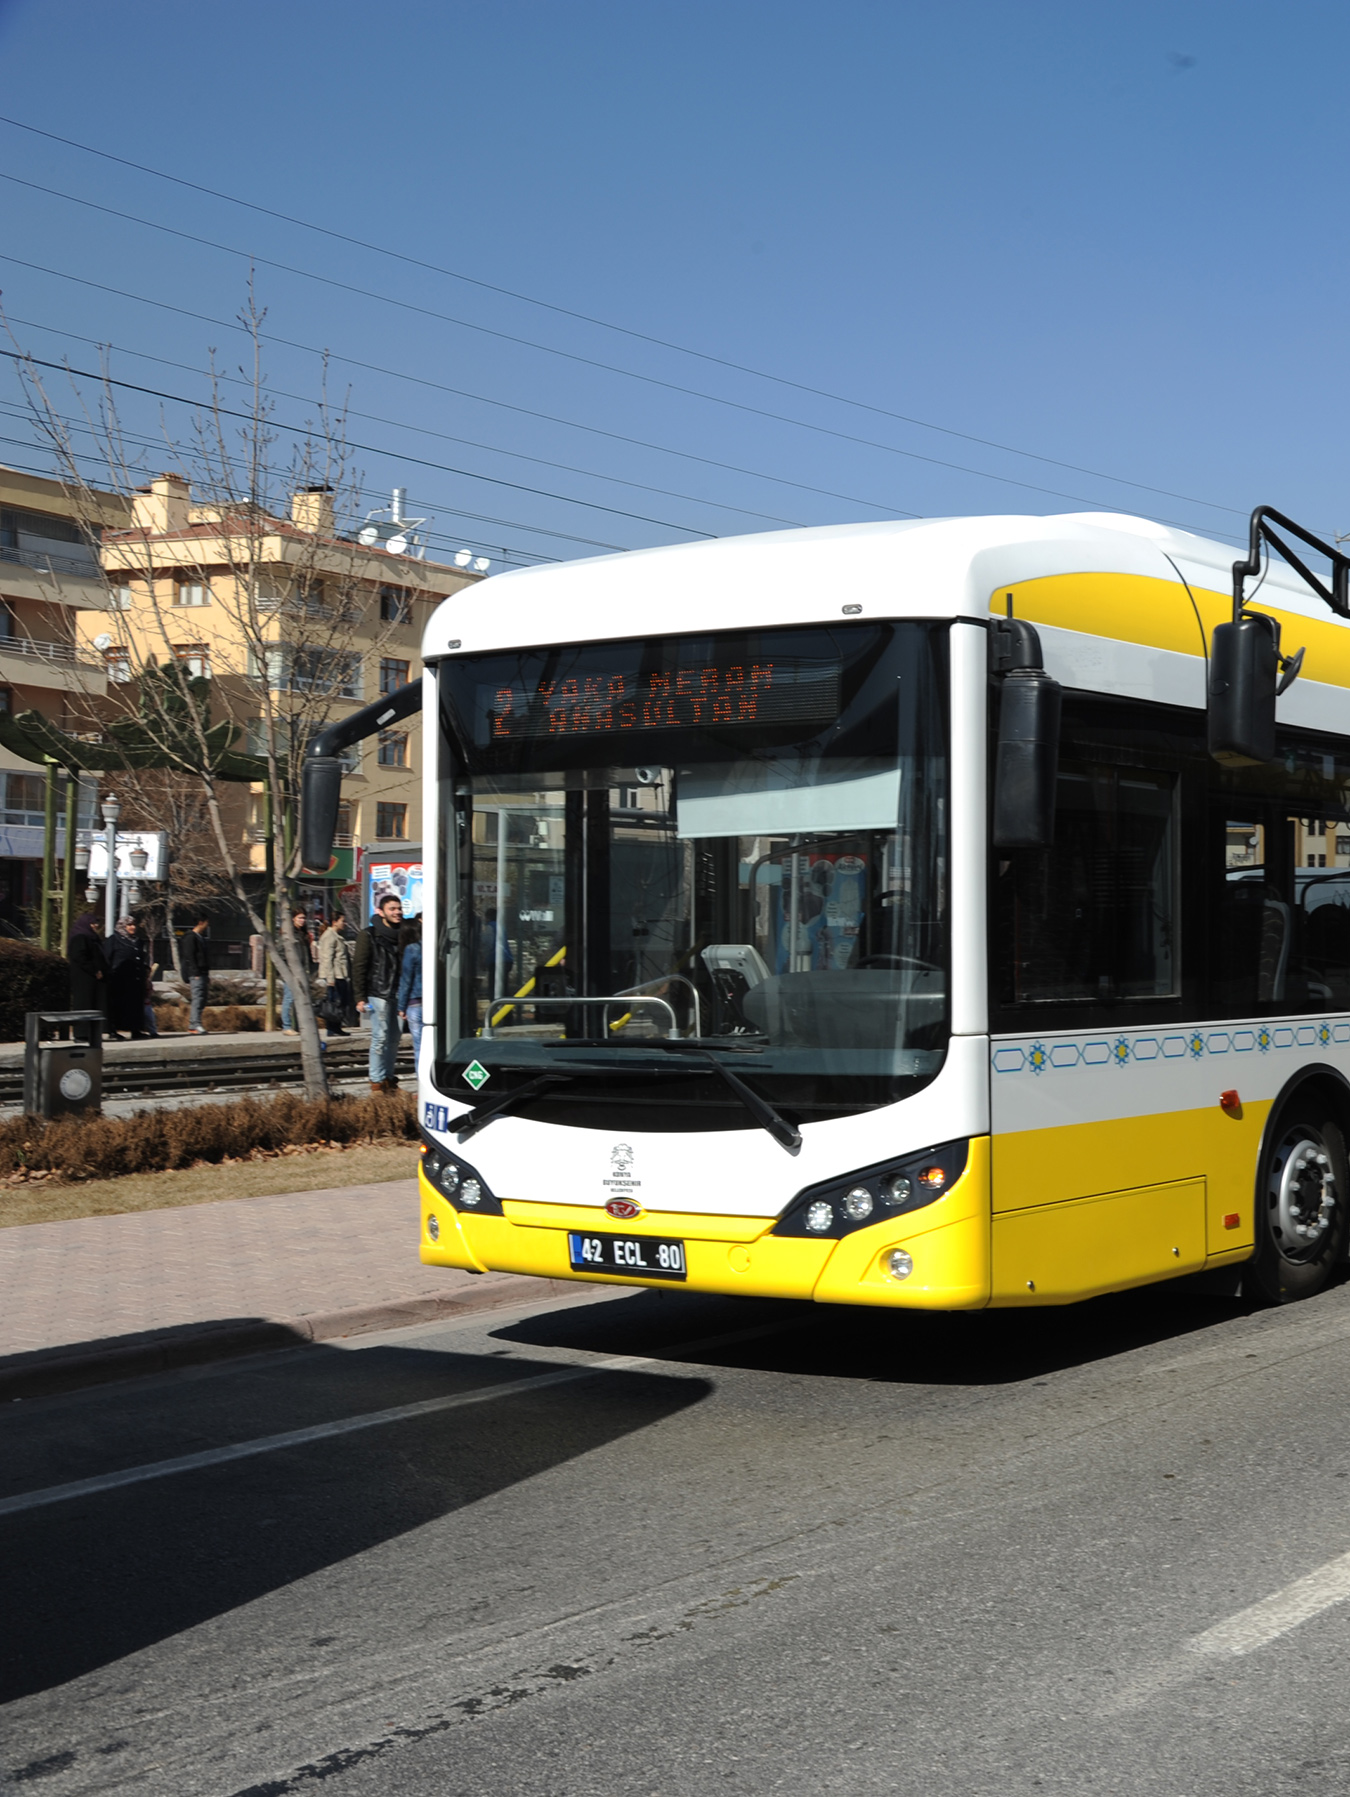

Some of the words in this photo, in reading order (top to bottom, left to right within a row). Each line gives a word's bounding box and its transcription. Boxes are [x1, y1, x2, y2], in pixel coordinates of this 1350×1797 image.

[494, 687, 513, 735] 2
[538, 674, 625, 705] YAKA
[649, 663, 774, 698] MERAM
[549, 693, 759, 732] ANASULTAN
[469, 1070, 484, 1080] CNG
[581, 1238, 604, 1263] 42
[613, 1240, 648, 1267] ECL
[658, 1244, 681, 1270] 80
